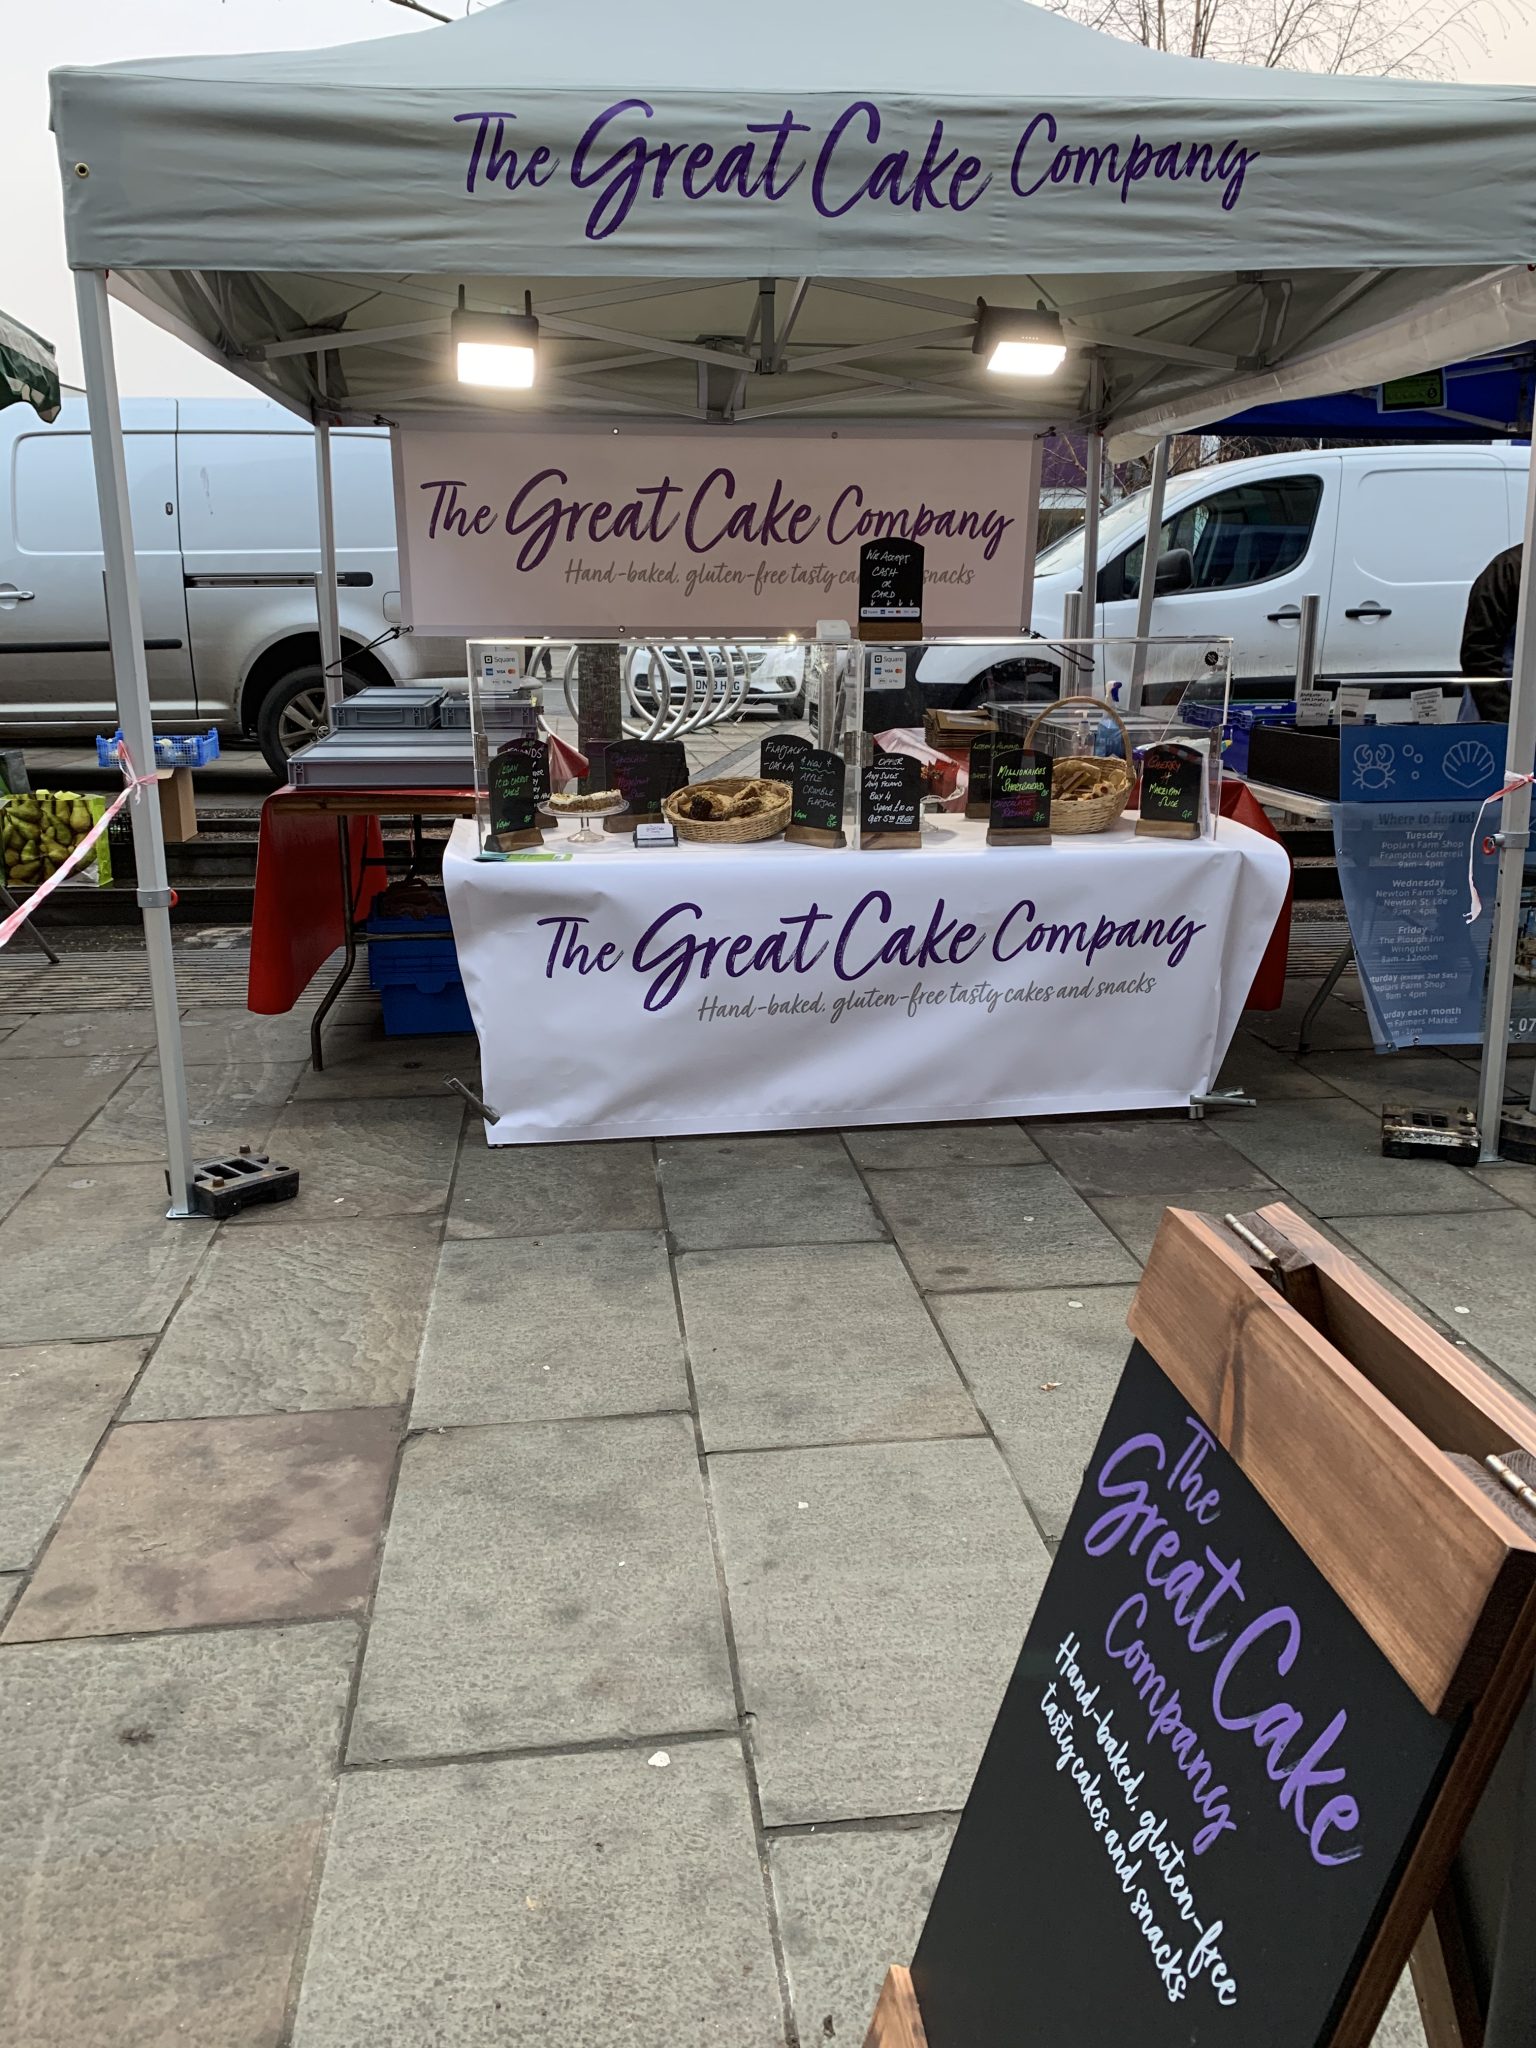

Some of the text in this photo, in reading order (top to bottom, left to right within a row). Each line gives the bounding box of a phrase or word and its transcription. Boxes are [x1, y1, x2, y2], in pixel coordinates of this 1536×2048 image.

[454, 99, 1261, 240] The Great Cake Company
[420, 468, 1015, 572] The Great Cake Company
[872, 566, 899, 577] CASH
[684, 560, 788, 597] gluten-free
[790, 562, 838, 593] tasty
[871, 590, 896, 598] CARD
[1405, 831, 1444, 841] Tuesday
[1417, 840, 1440, 849] Farm
[1442, 840, 1464, 849] Shop
[1392, 879, 1446, 888] Wednesday
[1376, 887, 1458, 897] Newton Farm Shop
[1384, 899, 1417, 907] Newton
[1398, 926, 1429, 935] Friday
[1379, 936, 1395, 945] The
[537, 890, 1207, 1012] The Great Cake Company
[1400, 981, 1422, 989] Farm
[1424, 980, 1447, 990] Shop
[830, 981, 948, 1024] gluten-free
[949, 980, 1003, 1013] tasty
[1004, 980, 1056, 1003] cakes
[1056, 976, 1095, 999] and
[1096, 971, 1158, 998] snacks
[1407, 1007, 1429, 1017] each
[1431, 1006, 1462, 1015] month
[1428, 1016, 1459, 1024] Market
[1084, 1416, 1364, 1866] The Great Cake
[1105, 1593, 1238, 1855] Company
[1041, 1682, 1186, 2003] tasty cakes and snacks
[1128, 1810, 1238, 2006] gluten-free
